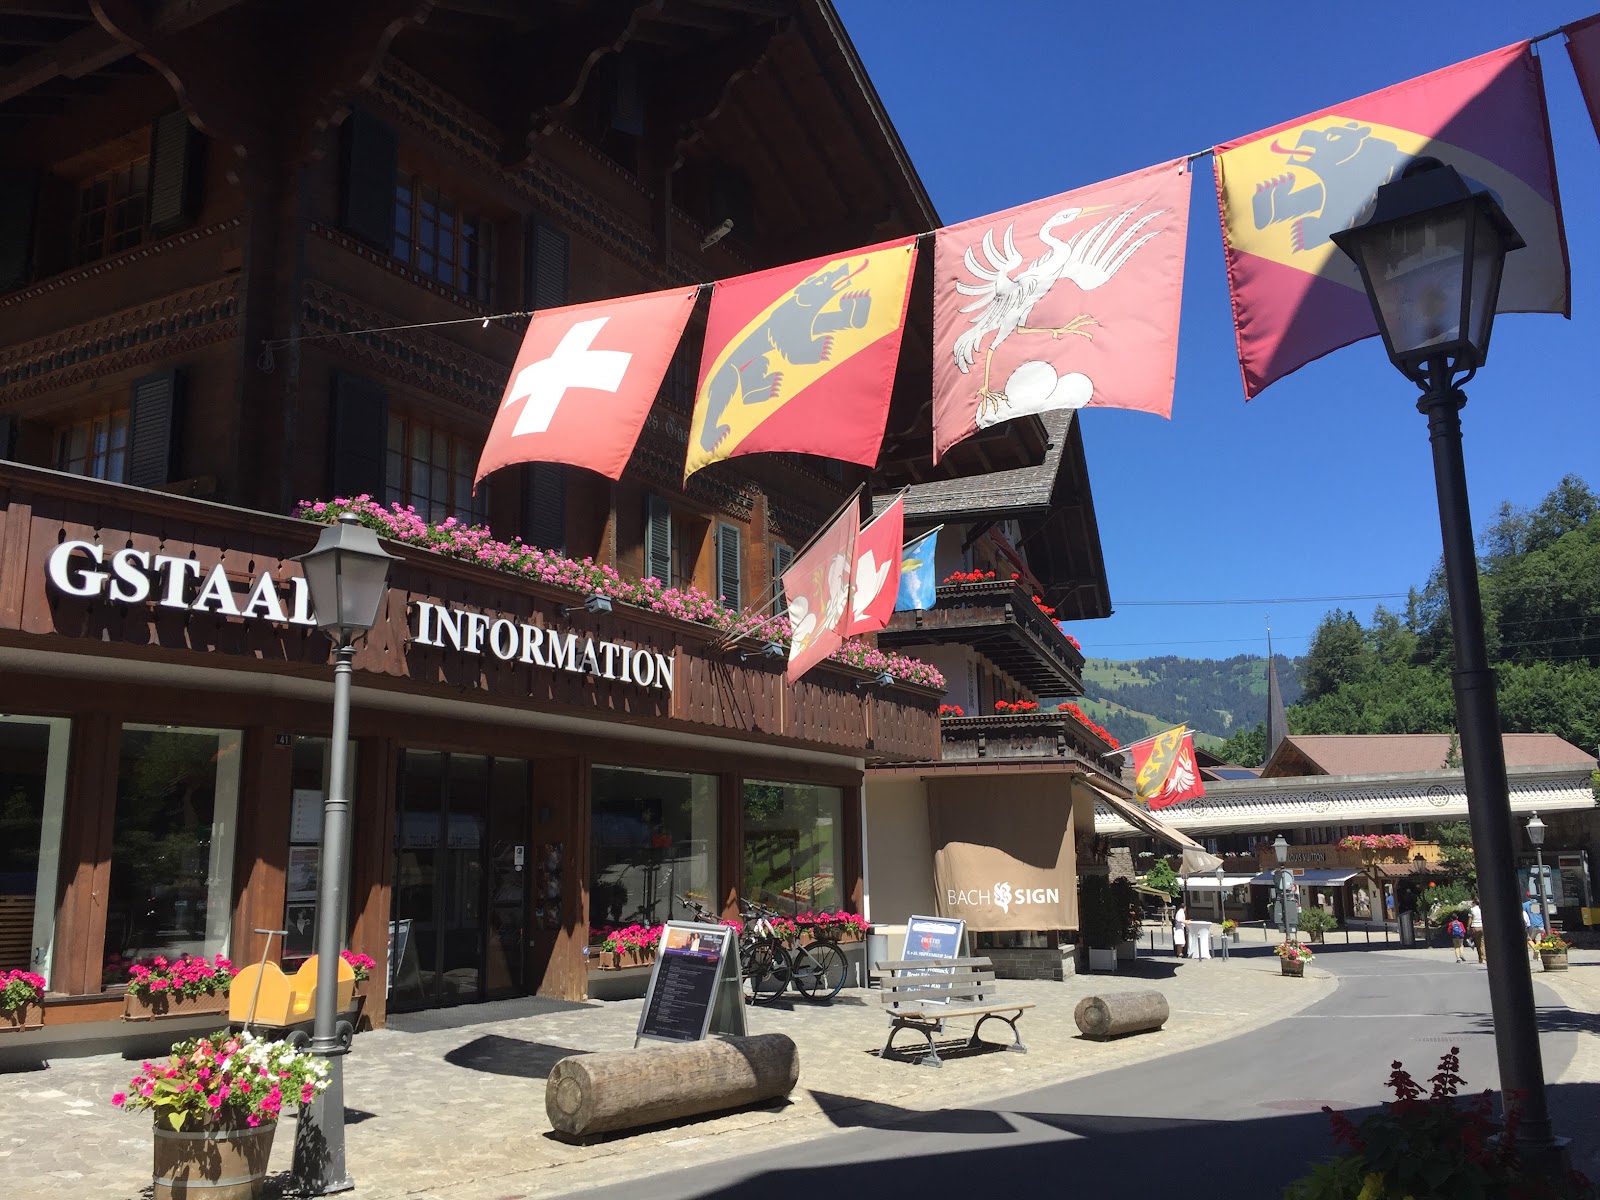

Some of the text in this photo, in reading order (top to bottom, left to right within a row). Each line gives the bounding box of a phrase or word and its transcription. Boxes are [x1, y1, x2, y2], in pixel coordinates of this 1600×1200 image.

[414, 600, 675, 691] INFORMATION
[947, 888, 1060, 906] BACH SIGN
